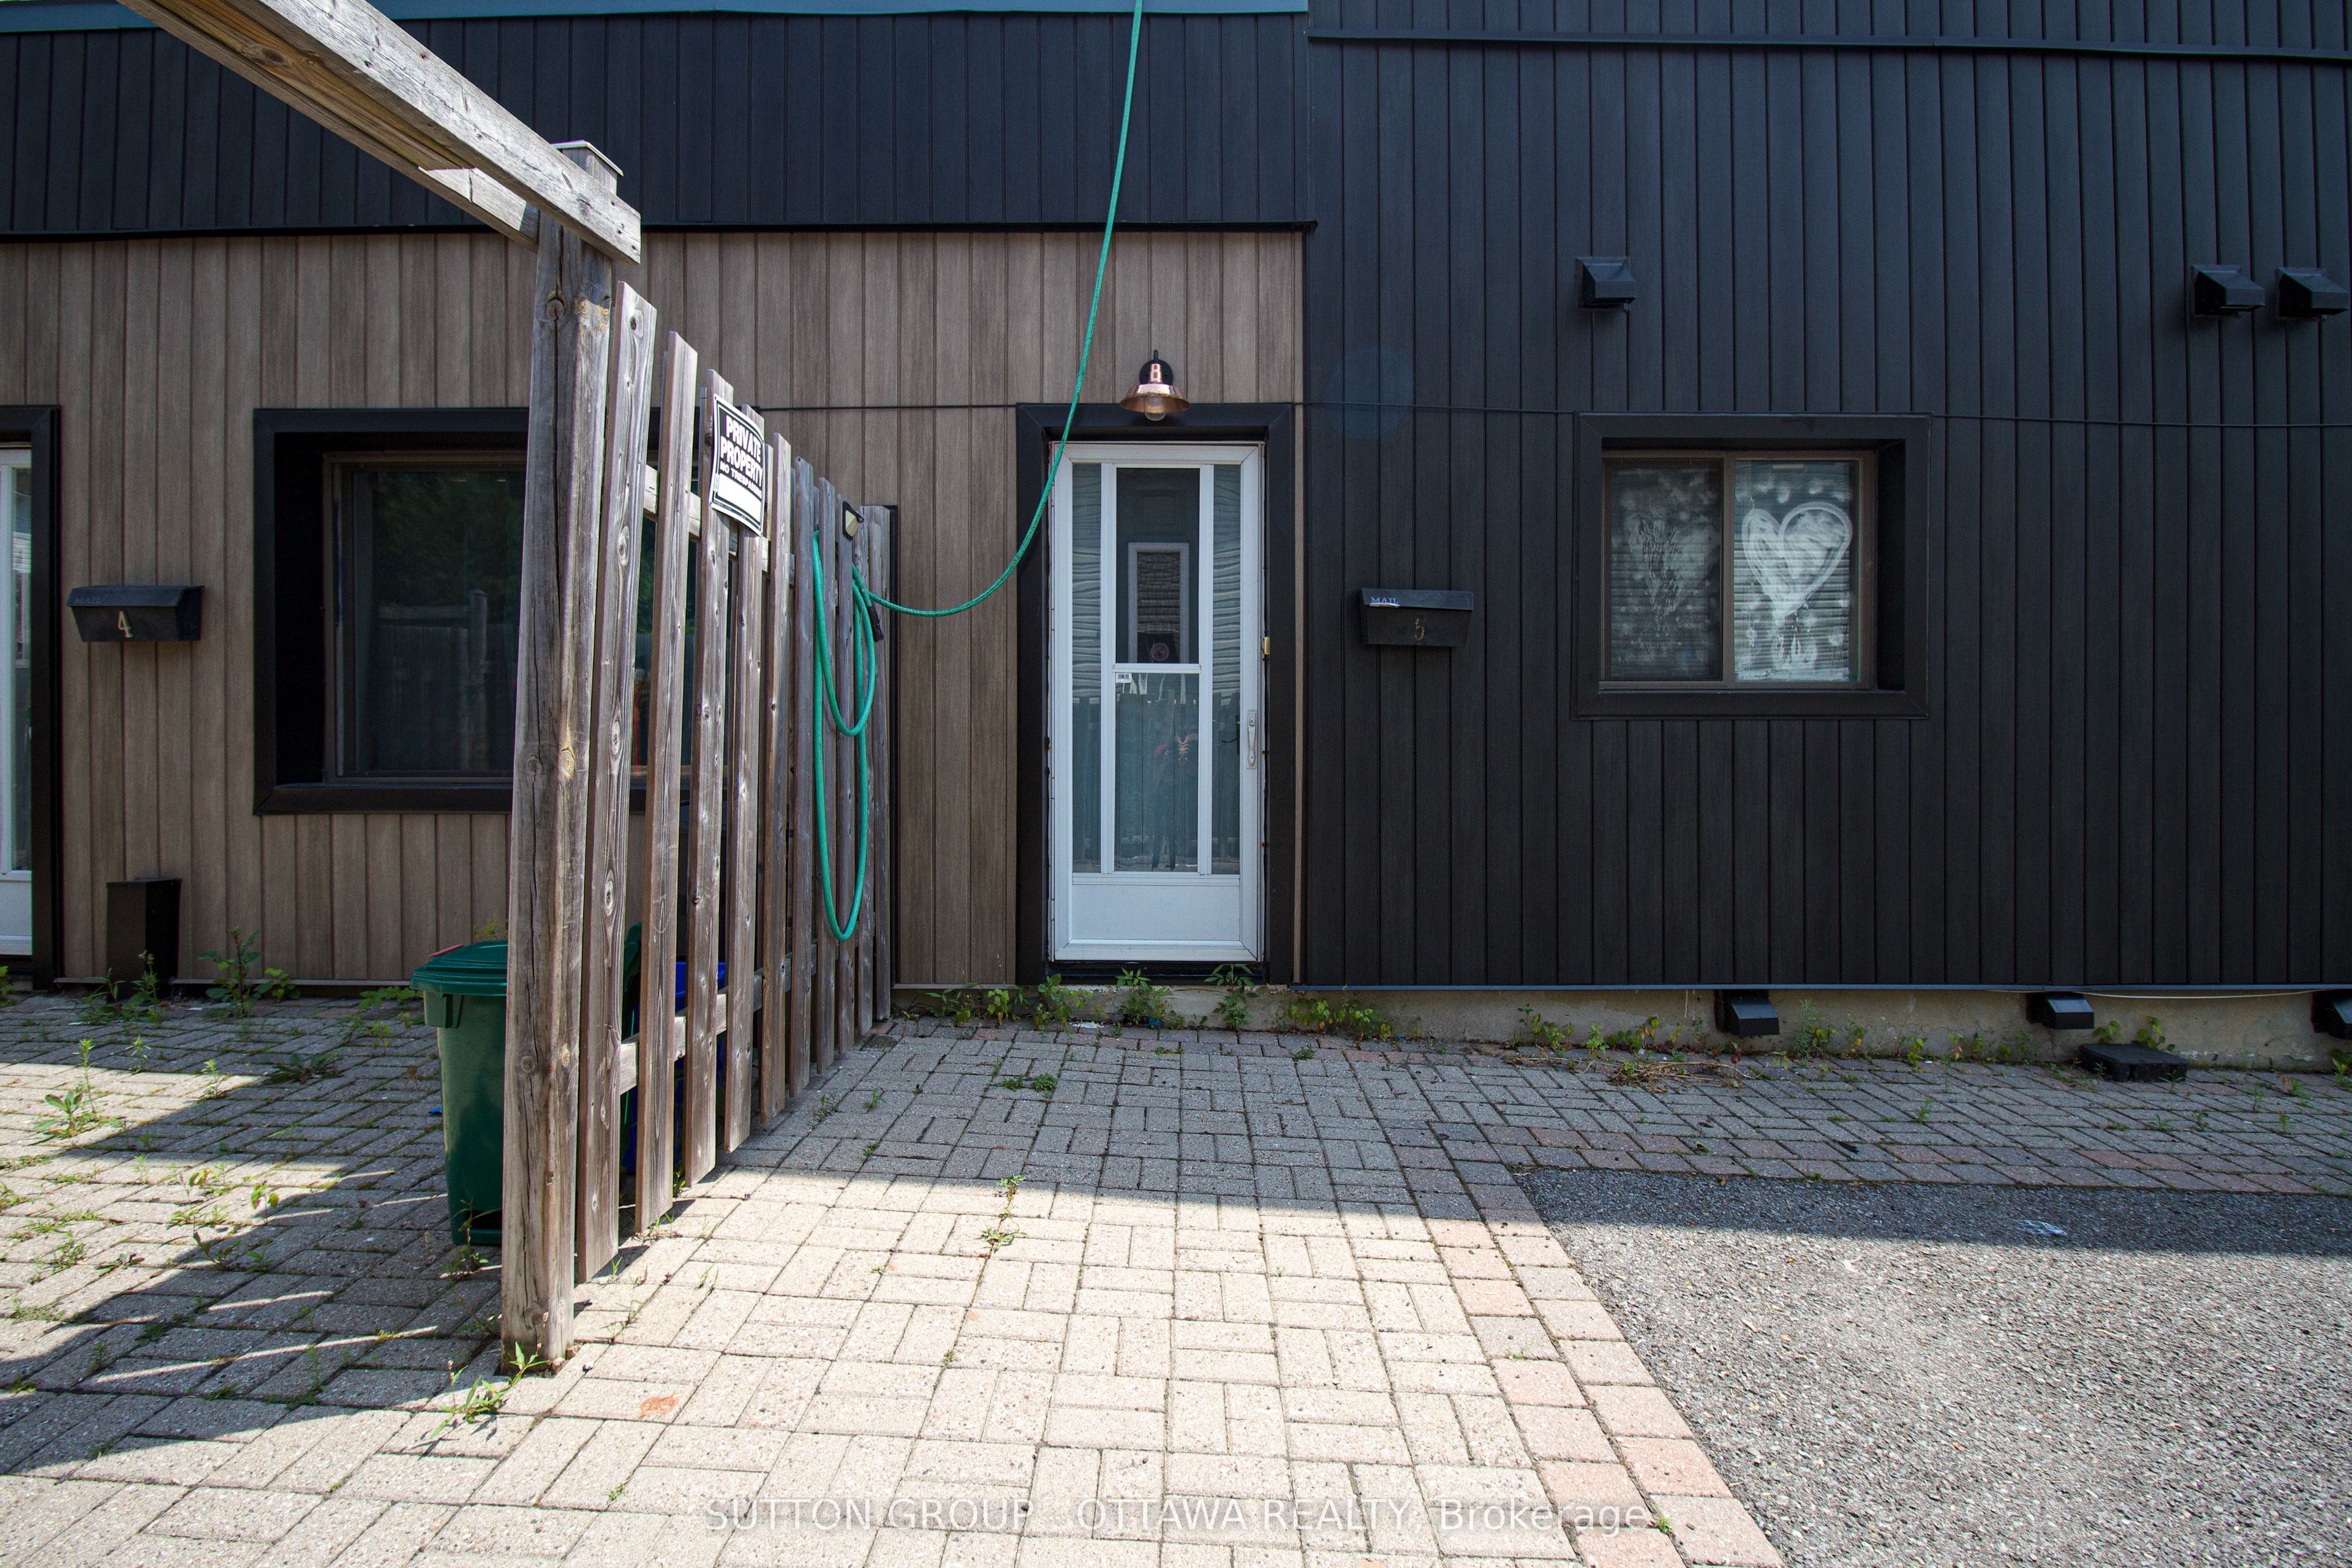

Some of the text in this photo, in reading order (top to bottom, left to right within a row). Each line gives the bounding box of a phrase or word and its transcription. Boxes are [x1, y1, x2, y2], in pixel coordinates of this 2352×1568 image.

[725, 415, 761, 464] PRIVATE
[719, 461, 730, 474] NO
[720, 435, 763, 488] PROPERTY
[118, 611, 134, 638] 4
[1415, 617, 1425, 641] 5
